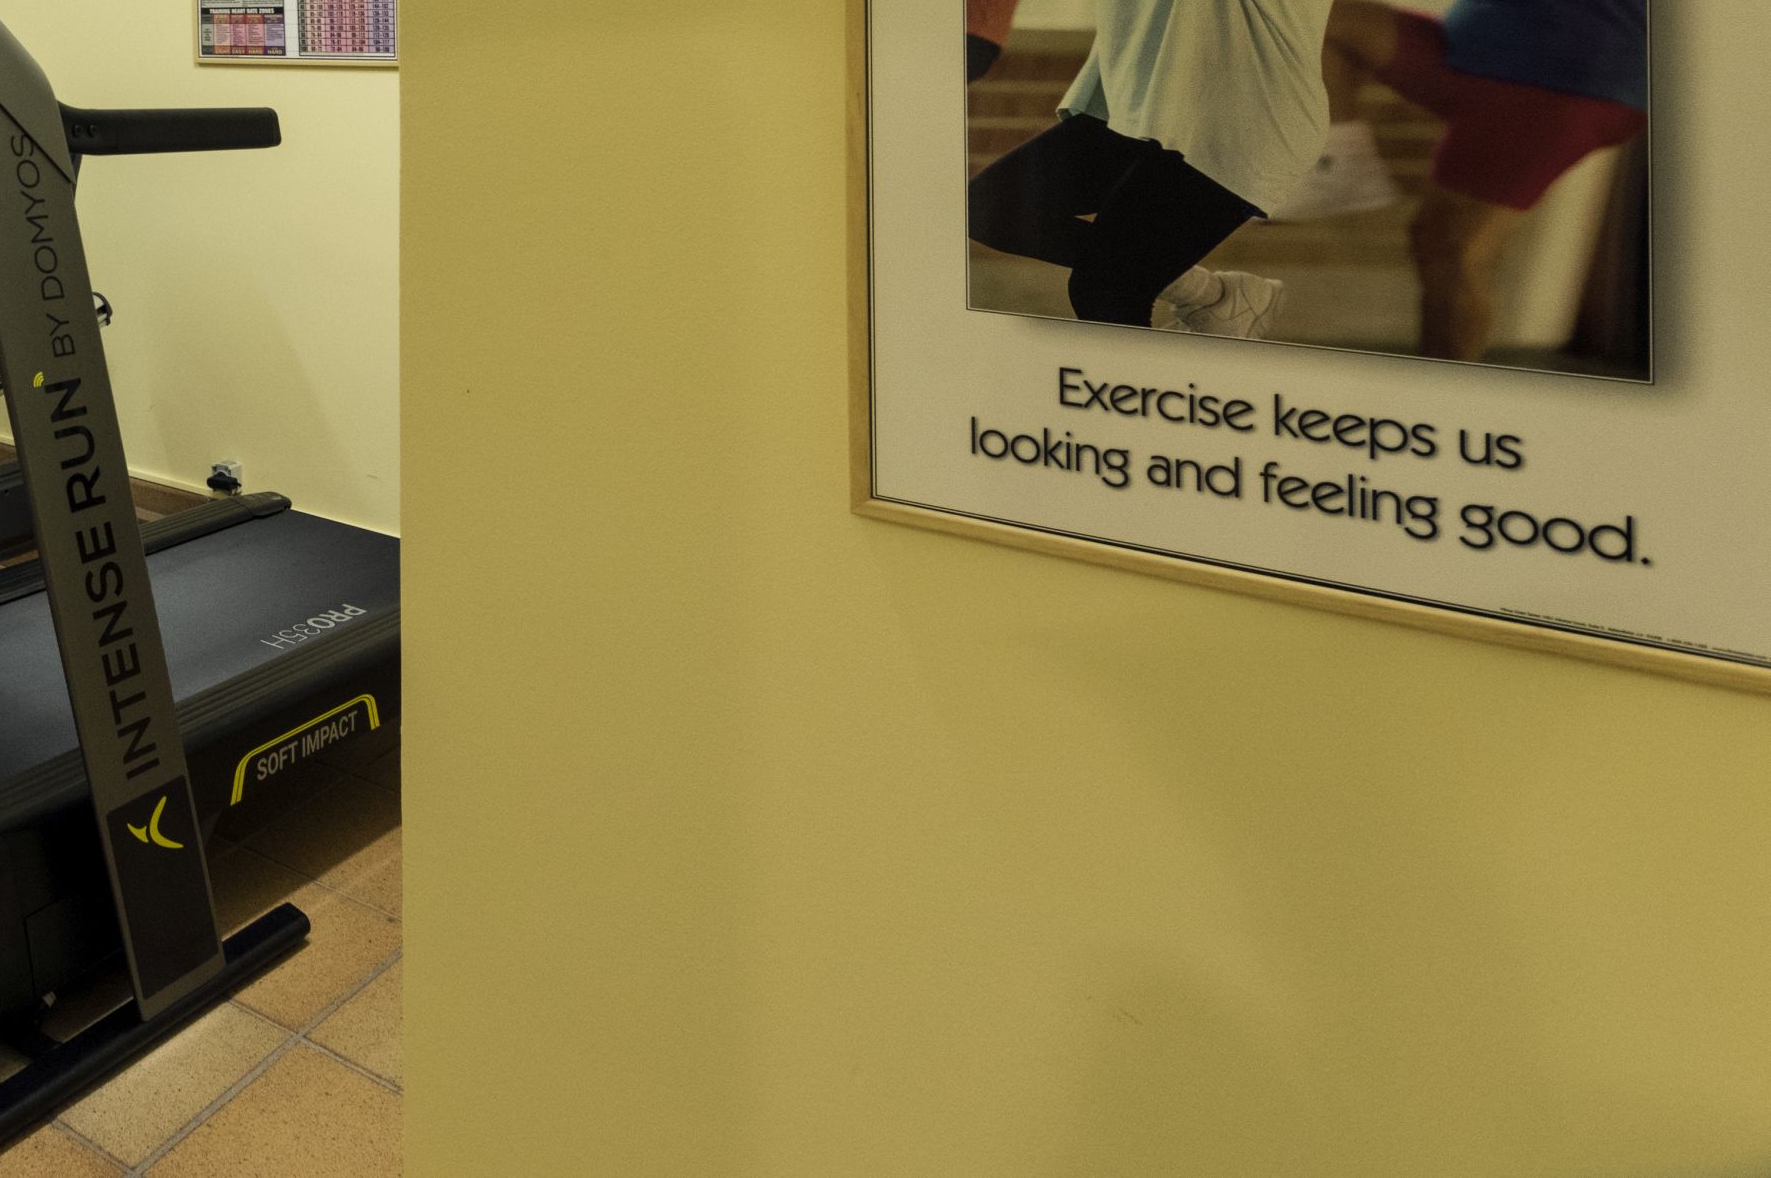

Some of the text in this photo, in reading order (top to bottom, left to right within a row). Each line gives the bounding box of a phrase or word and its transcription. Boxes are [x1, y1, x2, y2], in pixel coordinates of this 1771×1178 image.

[11, 134, 161, 782] INTENSE RUN BY DOMYOS
[1059, 366, 1524, 470] Exercise keeps us
[971, 416, 1652, 567] looking and feeling good.
[260, 604, 367, 650] PRO35H
[257, 710, 358, 781] SOFT IMPACT
